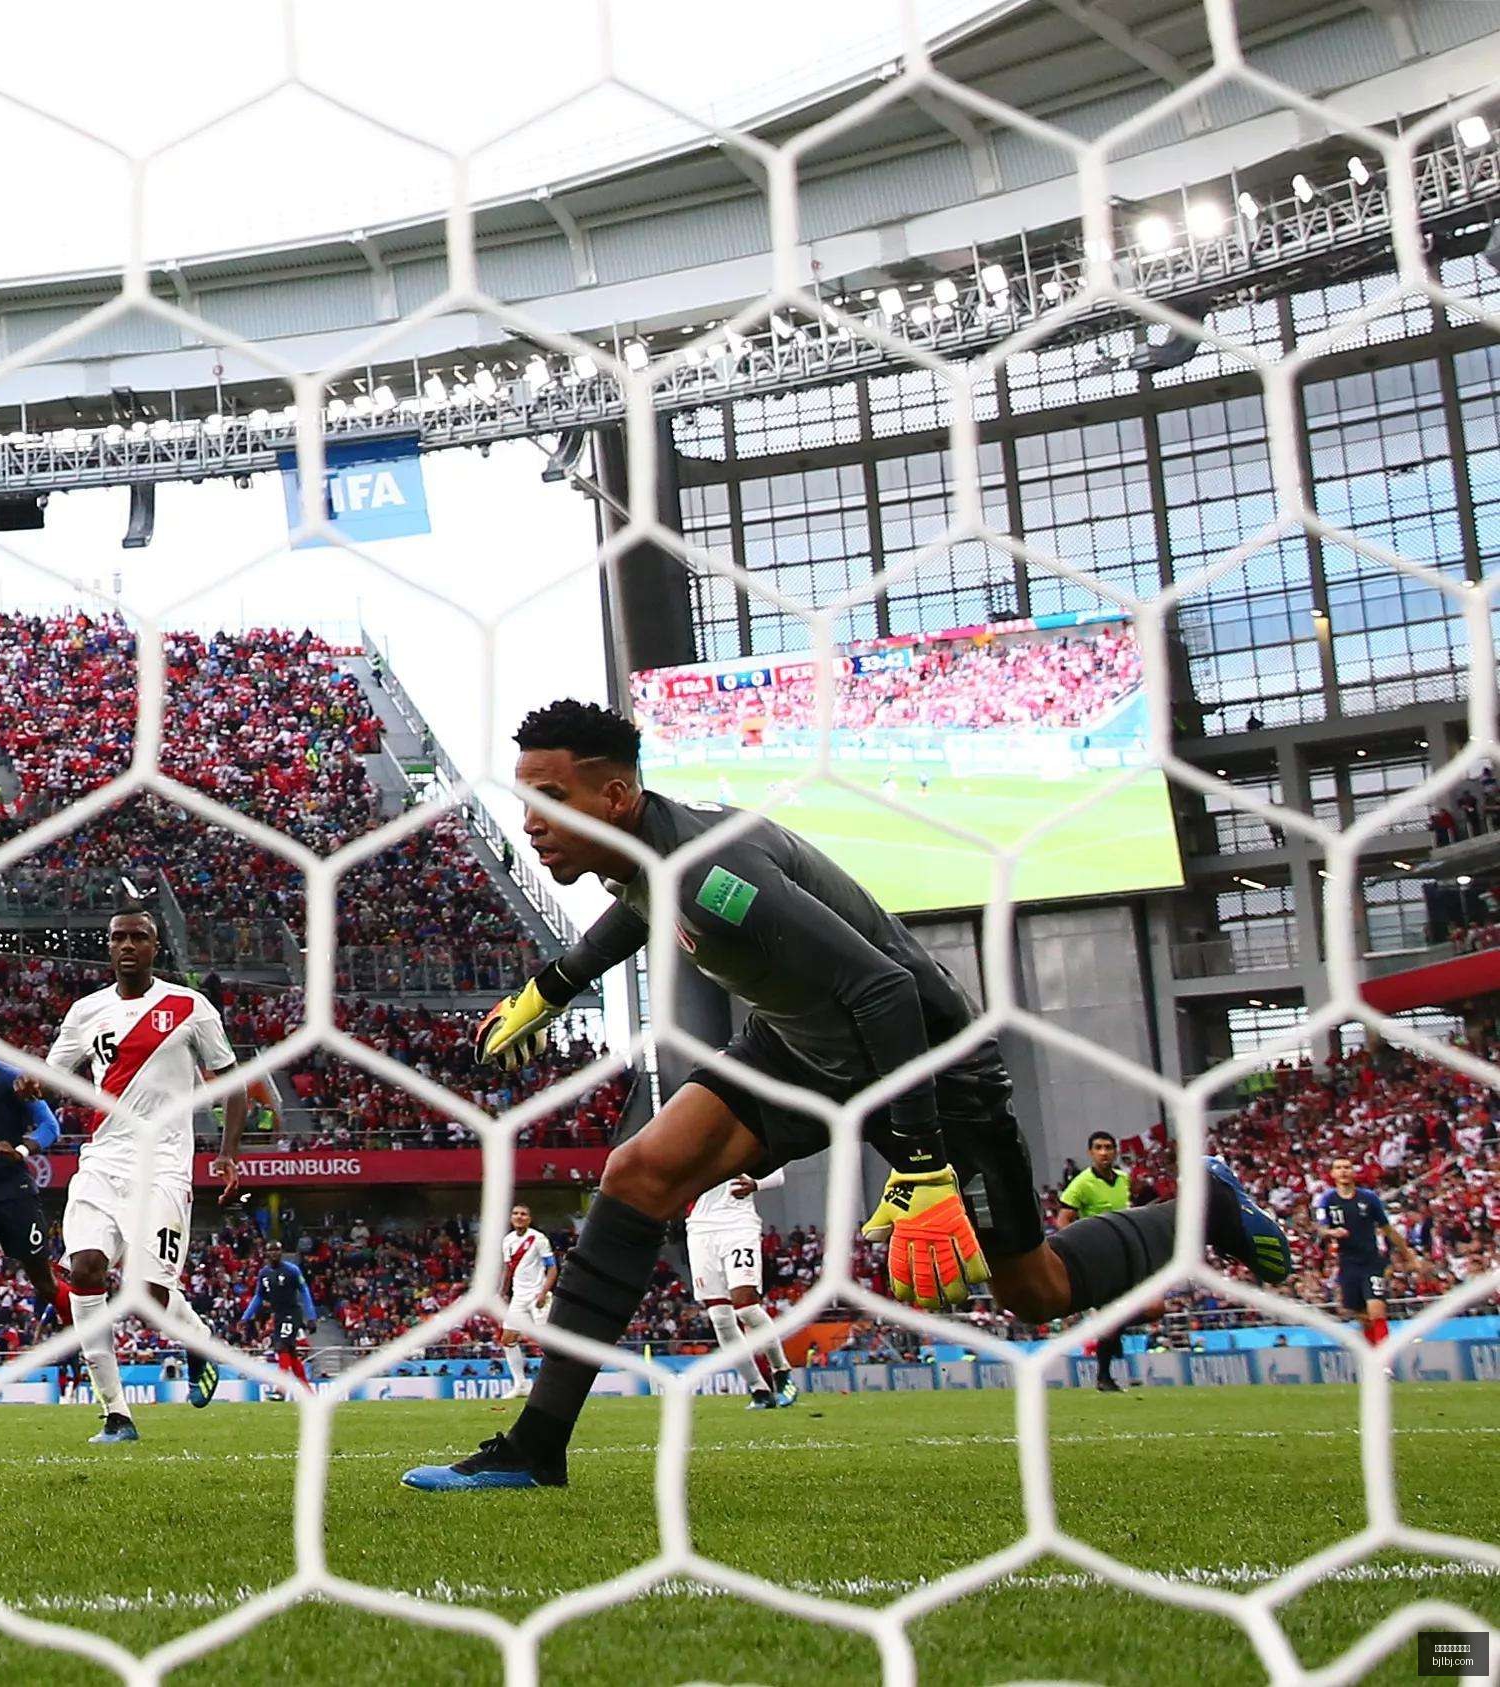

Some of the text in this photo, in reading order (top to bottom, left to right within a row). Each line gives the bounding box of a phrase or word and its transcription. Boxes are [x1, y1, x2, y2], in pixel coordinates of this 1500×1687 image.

[310, 472, 406, 513] IFA
[673, 680, 709, 697] FRA
[93, 1031, 117, 1065] 15
[209, 1158, 360, 1177] EATERINBURG
[30, 1223, 43, 1245] 6
[157, 1227, 181, 1264] 15
[731, 1249, 755, 1268] 23
